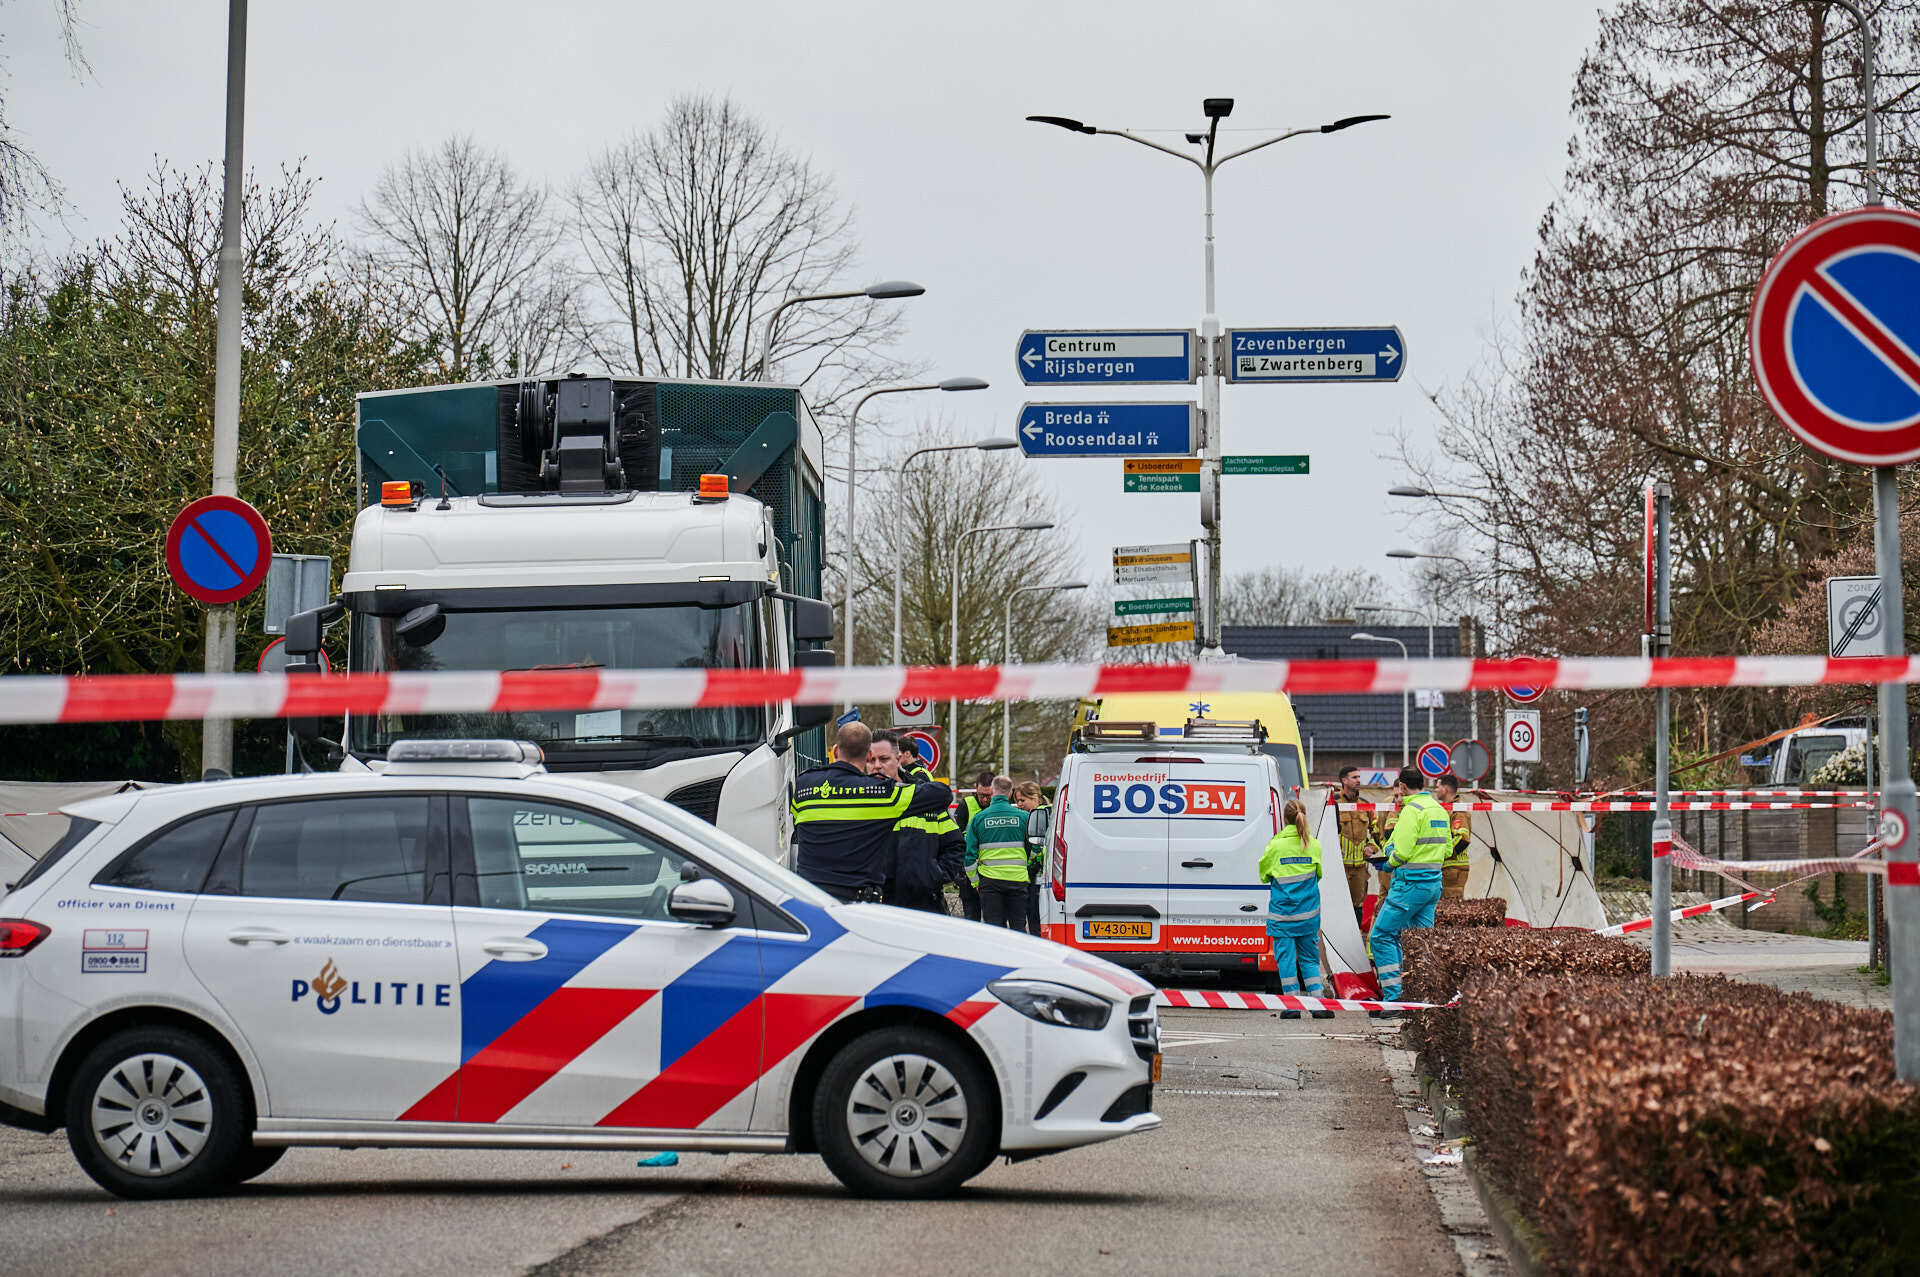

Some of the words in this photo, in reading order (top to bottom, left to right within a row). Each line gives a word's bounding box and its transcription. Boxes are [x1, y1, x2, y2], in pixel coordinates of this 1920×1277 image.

[1048, 339, 1116, 352] Centrum
[1236, 336, 1346, 353] Zevenbergen
[1045, 360, 1135, 377] Rijsbergen
[1260, 357, 1363, 373] Zwartenberg
[1045, 411, 1093, 424] Breda
[1045, 432, 1142, 446] Roosendaal
[1138, 475, 1180, 483] Tennispark
[1151, 483, 1183, 491] Koekoek
[1847, 584, 1875, 592] ZONE
[1128, 601, 1190, 612] Boerderijcamping
[1514, 730, 1531, 743] 30
[1093, 773, 1167, 782] Bouwbedrijf
[812, 781, 865, 799] POLITIE
[1093, 784, 1185, 814] BOS
[1193, 791, 1241, 810] B.V.
[513, 811, 576, 826] zero
[524, 863, 590, 875] SCANIA
[57, 899, 105, 909] Officier
[108, 901, 131, 909] van
[135, 901, 176, 911] Dienst
[1093, 924, 1148, 935] V-430-NL
[107, 933, 125, 945] 112
[303, 936, 364, 946] waakzaam
[382, 938, 442, 948] dienstbaar
[1172, 935, 1265, 946] www.bosbv.com
[291, 979, 451, 1015] POLITIE
